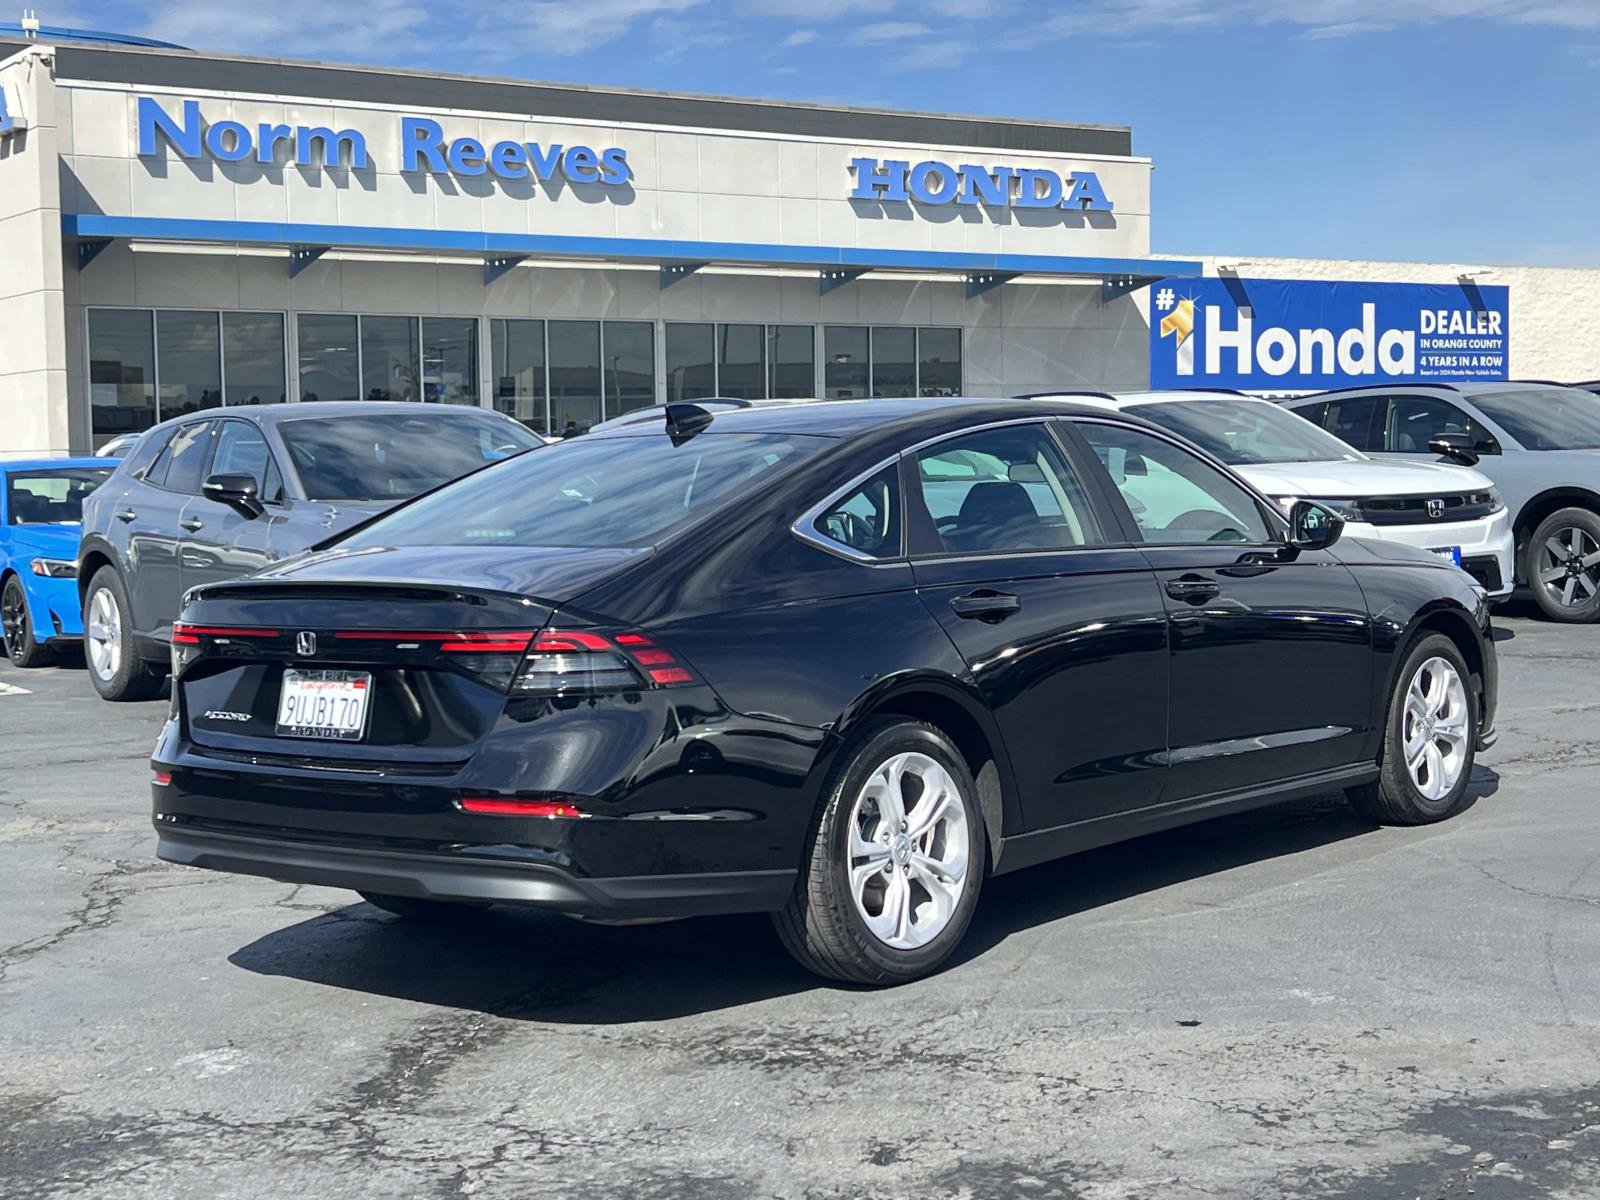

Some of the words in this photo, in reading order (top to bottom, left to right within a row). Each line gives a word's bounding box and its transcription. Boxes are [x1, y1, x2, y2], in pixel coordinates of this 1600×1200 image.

[137, 97, 367, 168] Norm
[401, 116, 630, 185] Reeves
[851, 157, 1114, 211] HONDA
[1420, 309, 1503, 335] DEALER
[1205, 302, 1416, 376] Honda
[1420, 339, 1431, 349] IN
[1432, 339, 1467, 349] ORANGE
[1468, 339, 1503, 349] COUNTY
[1420, 356, 1427, 366] 4
[1429, 356, 1458, 367] YEARS
[1460, 356, 1470, 367] IN
[1471, 356, 1479, 367] A
[1480, 356, 1503, 367] ROW
[284, 695, 360, 728] 9UJB170
